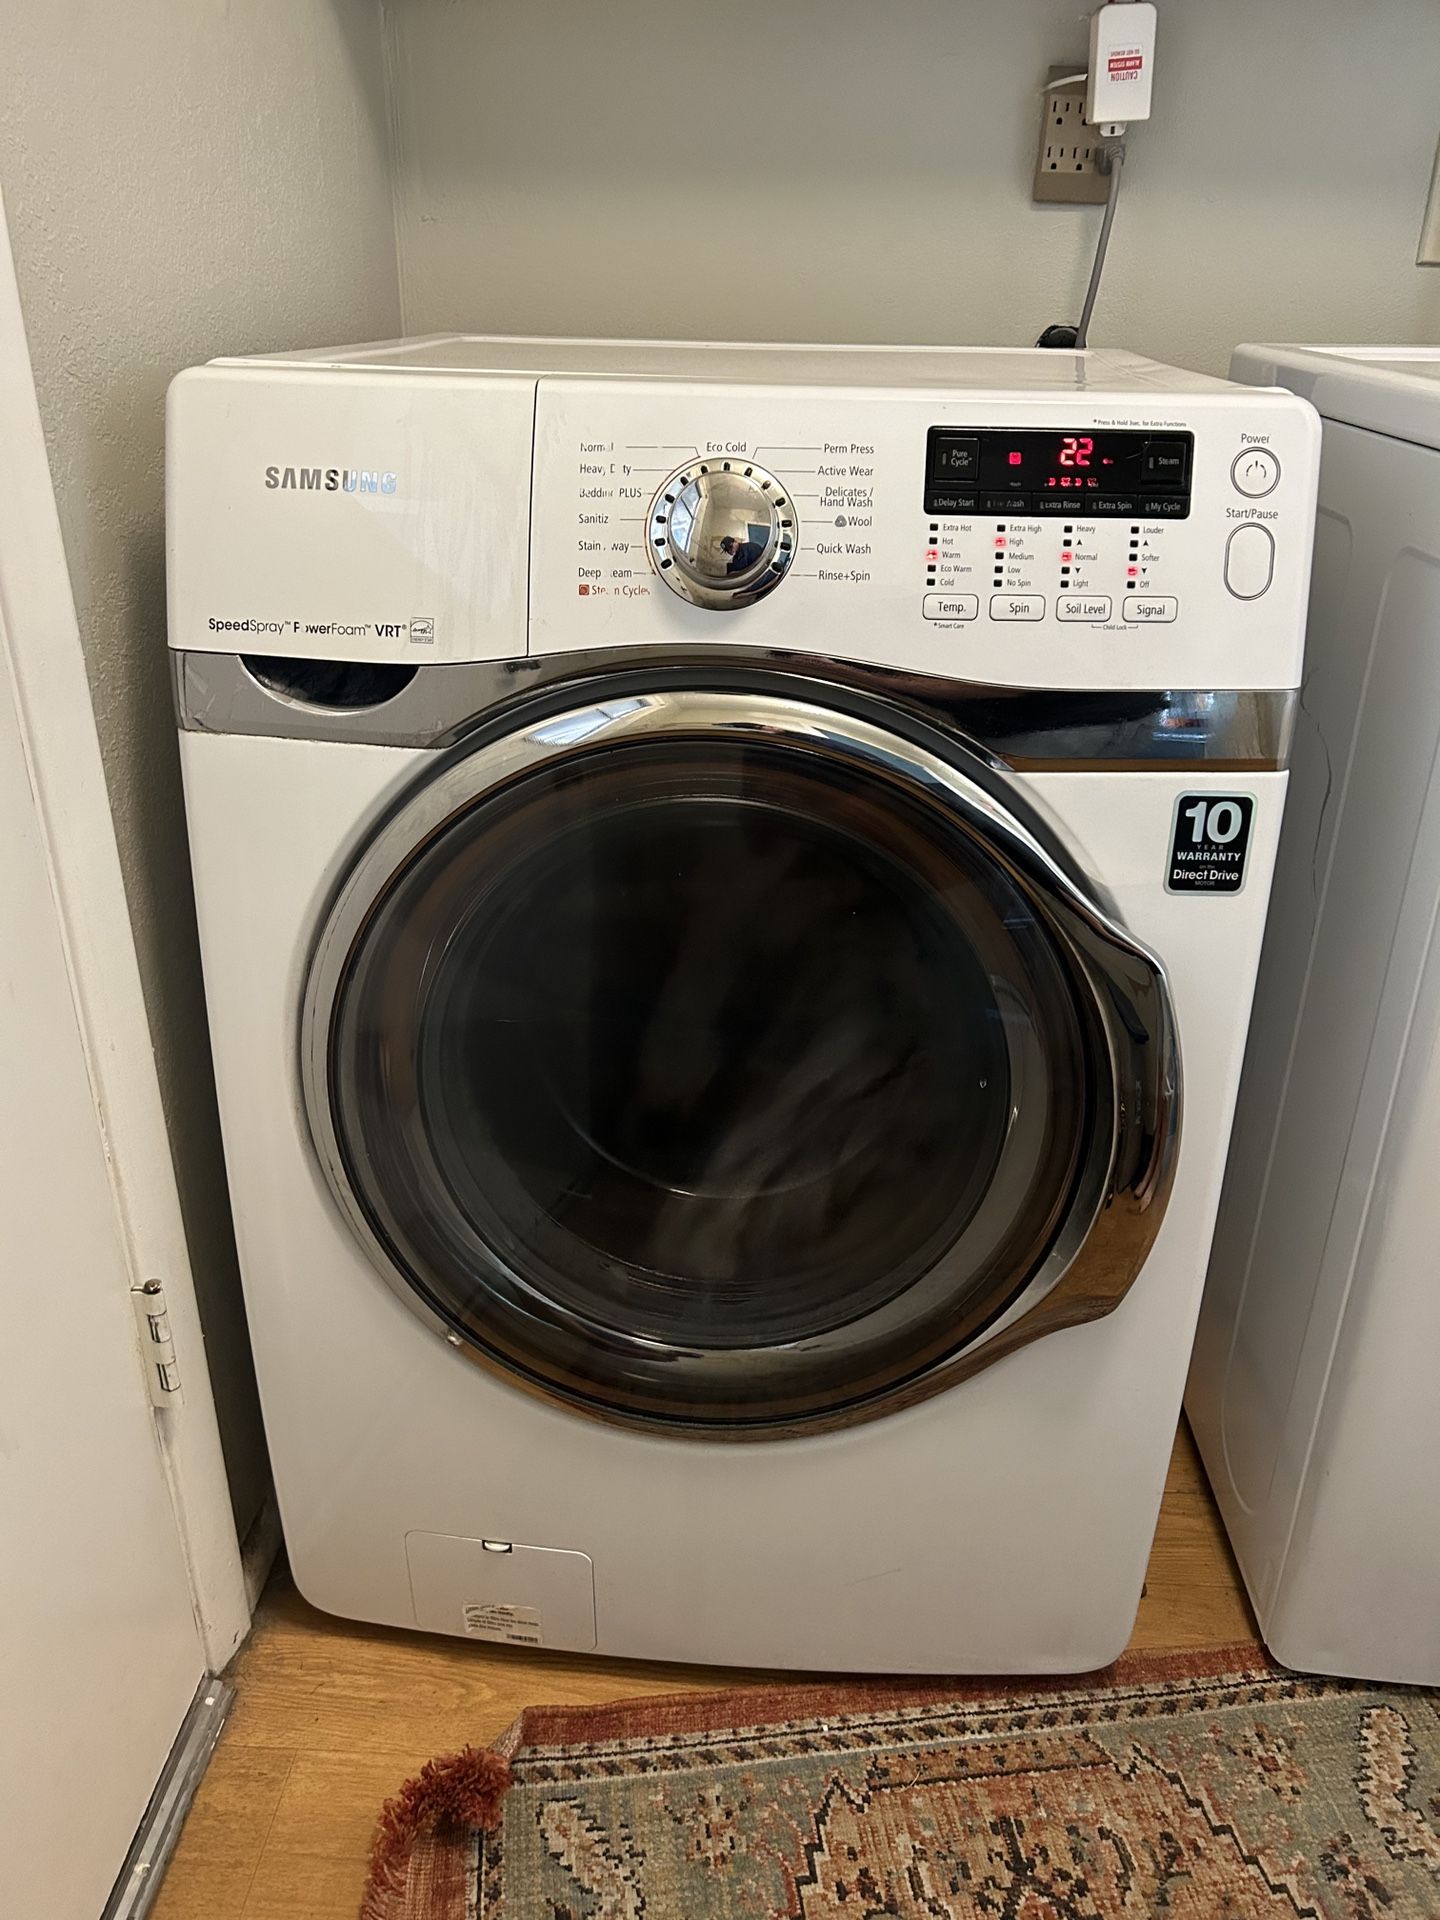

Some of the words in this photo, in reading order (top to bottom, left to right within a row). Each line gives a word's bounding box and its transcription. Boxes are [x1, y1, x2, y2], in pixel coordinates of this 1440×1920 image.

[1111, 71, 1137, 81] CAUTION
[1241, 433, 1270, 444] Power
[581, 442, 614, 452] Norml
[707, 441, 722, 452] Eco
[726, 441, 746, 452] Cold
[824, 443, 848, 453] Perm
[851, 443, 874, 454] Press
[1060, 438, 1093, 465] 22
[953, 449, 968, 458] Pure
[1159, 456, 1180, 466] Steam
[610, 463, 631, 476] Dty
[818, 465, 846, 476] Active
[849, 465, 874, 476] Wear
[265, 466, 397, 494] SAMSUNG
[620, 487, 642, 498] PLUS
[826, 486, 867, 497] Delicates
[820, 497, 844, 507] Hand
[847, 497, 872, 507] Wash
[939, 498, 956, 508] Delay
[959, 498, 974, 507] Start
[1063, 501, 1080, 509] Rinse
[1099, 501, 1116, 509] Extra
[1118, 501, 1132, 511] Spin
[1151, 502, 1161, 512] My
[1163, 502, 1180, 512] Cycle
[1226, 507, 1278, 519] Start/Pause
[848, 516, 872, 526] Wool
[943, 524, 958, 532] Extra
[961, 524, 972, 532] Hot
[1010, 524, 1026, 532] Extra
[1028, 525, 1042, 534] High
[1077, 525, 1096, 534] Heavy
[1144, 526, 1164, 534] Louder
[579, 540, 600, 551] Stain
[604, 543, 630, 554] way
[1010, 538, 1024, 547] High
[817, 543, 843, 554] Quick
[846, 543, 872, 554] Wash
[1142, 554, 1160, 562] Softer
[579, 567, 601, 580] Deep
[610, 569, 632, 578] eam
[1008, 566, 1020, 574] Low
[819, 569, 870, 583] Rinse+Spin
[940, 578, 954, 586] Cold
[1018, 579, 1032, 588] Spin
[1073, 580, 1088, 588] Light
[1140, 580, 1150, 588] Off
[938, 601, 966, 614] Temp.
[1010, 602, 1030, 615] Spin
[1066, 603, 1082, 614] Soil
[1084, 604, 1106, 614] Level
[1137, 604, 1166, 617] Signal
[1185, 801, 1242, 843] 10
[1177, 851, 1242, 861] WARRANTY
[1173, 869, 1208, 880] Direct
[1210, 870, 1239, 880] Drive
